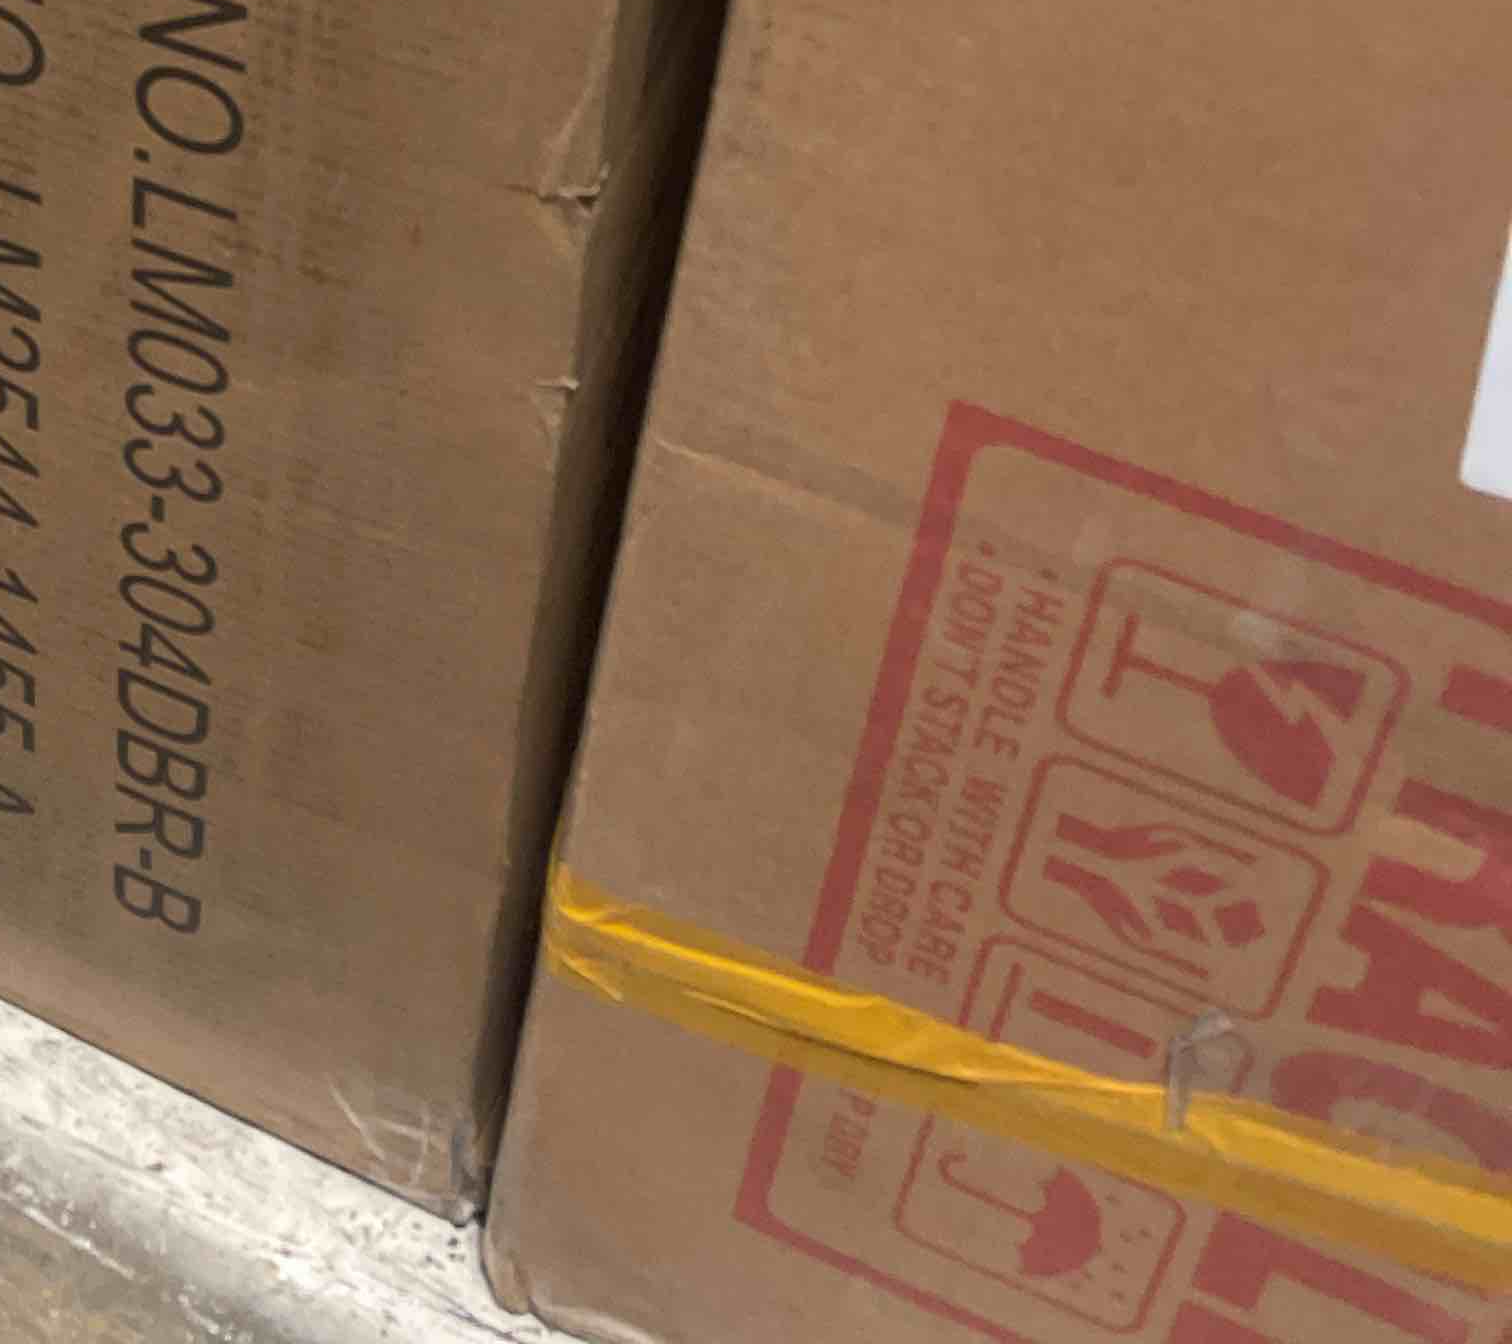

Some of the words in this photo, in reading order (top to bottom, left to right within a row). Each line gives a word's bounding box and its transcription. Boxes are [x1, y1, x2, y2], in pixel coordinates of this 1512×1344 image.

[971, 585, 1065, 763] HANDLE
[897, 687, 969, 815] STACK
[879, 810, 933, 866] OR
[941, 775, 1009, 882] WITH
[855, 863, 914, 968] DROP
[905, 880, 973, 988] CARE
